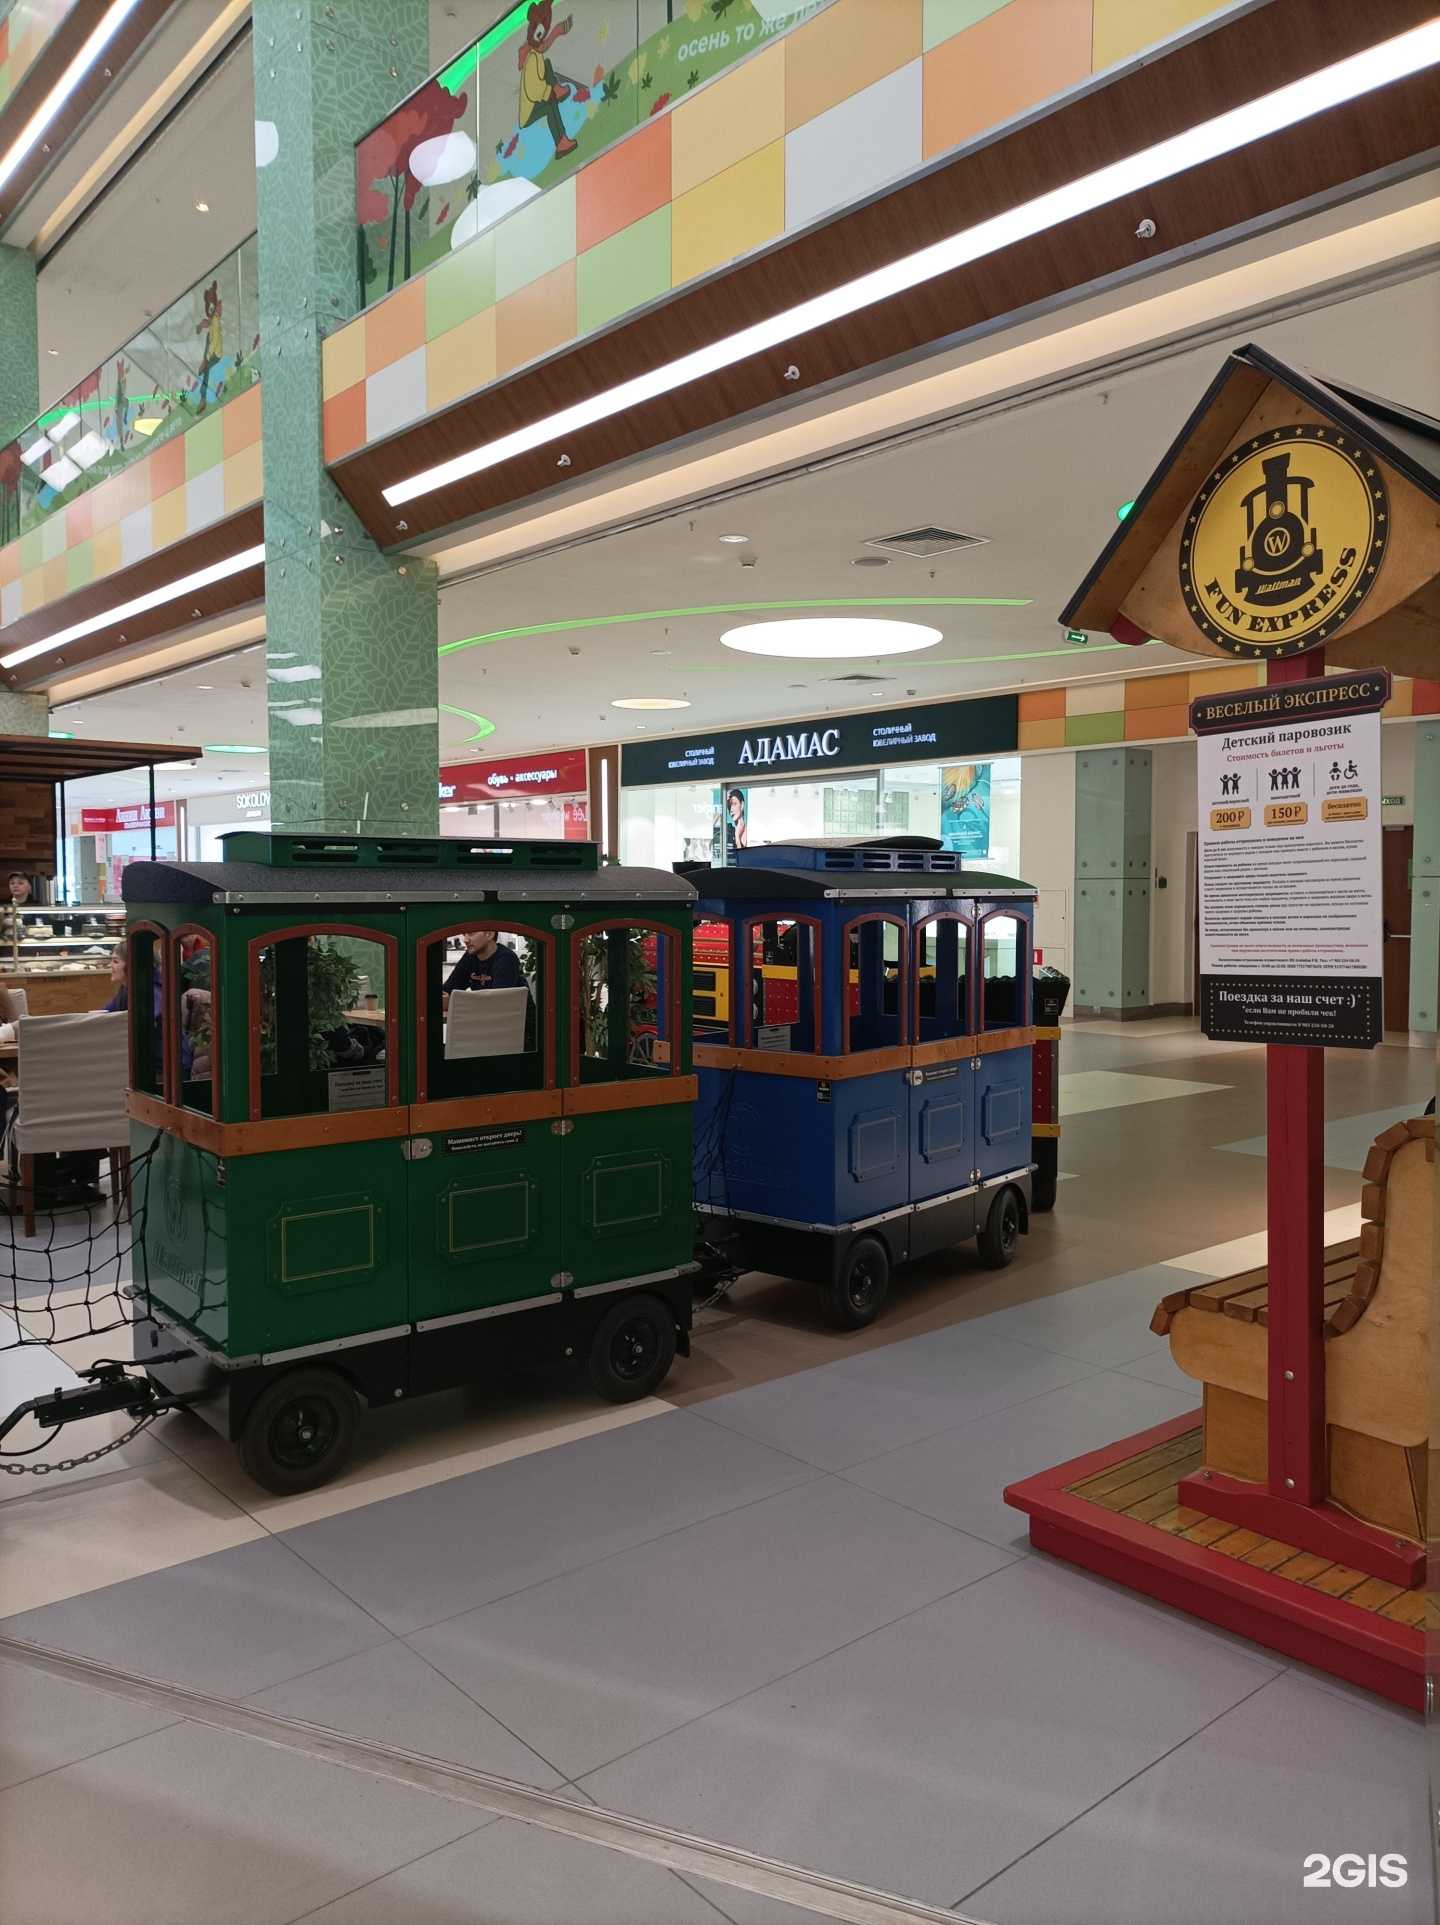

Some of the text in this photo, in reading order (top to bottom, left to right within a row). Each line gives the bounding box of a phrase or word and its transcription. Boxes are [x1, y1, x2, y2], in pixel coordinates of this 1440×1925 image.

[677, 30, 730, 62] осень
[735, 23, 755, 44] то
[1204, 547, 1357, 633] FUN EXPRESS
[1206, 683, 1371, 720] ВЕСЕЛЫЙ ЭКСПРЕСС
[738, 728, 840, 766] АДАМАС
[914, 733, 937, 743] ЗАВОД
[1221, 723, 1352, 751] Детский паровозик
[1226, 742, 1345, 762] Стоимость билетов и льготы
[487, 769, 558, 787] обувь аксессуары
[1219, 990, 1268, 1005] Поездка
[1270, 993, 1284, 1003] за
[1286, 994, 1312, 1004] наш
[1315, 995, 1344, 1005] счет
[1287, 1008, 1319, 1017] пробили
